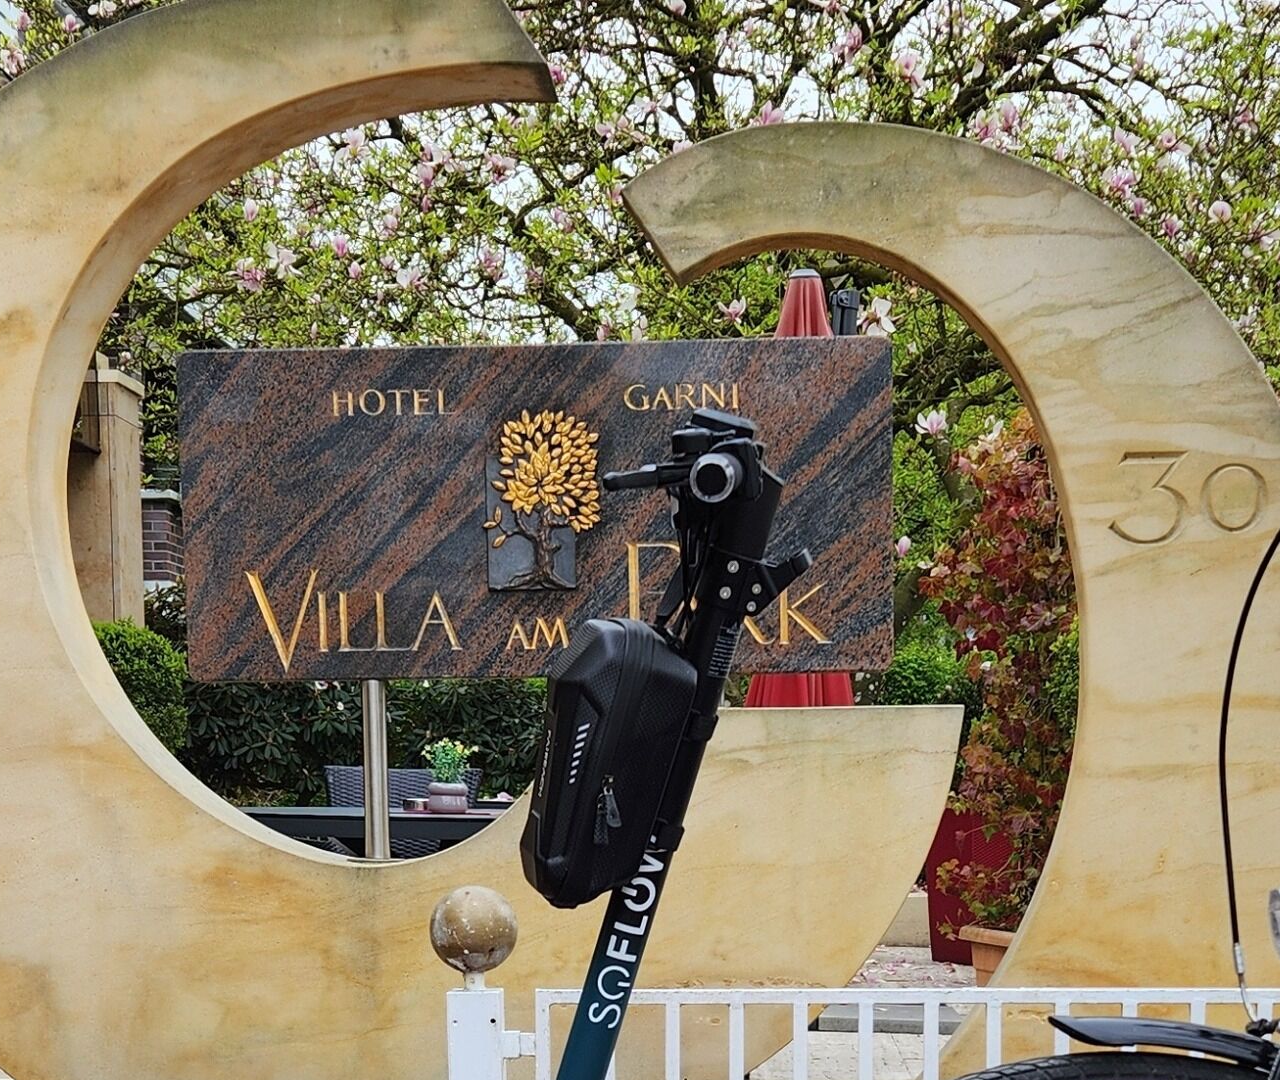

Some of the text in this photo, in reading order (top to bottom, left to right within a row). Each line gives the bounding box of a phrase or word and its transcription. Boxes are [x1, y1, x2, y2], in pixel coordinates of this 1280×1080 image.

[331, 382, 741, 418] HOTEL GARNI
[1107, 450, 1268, 546] 30
[244, 568, 464, 673] VILLA
[506, 616, 569, 650] AM
